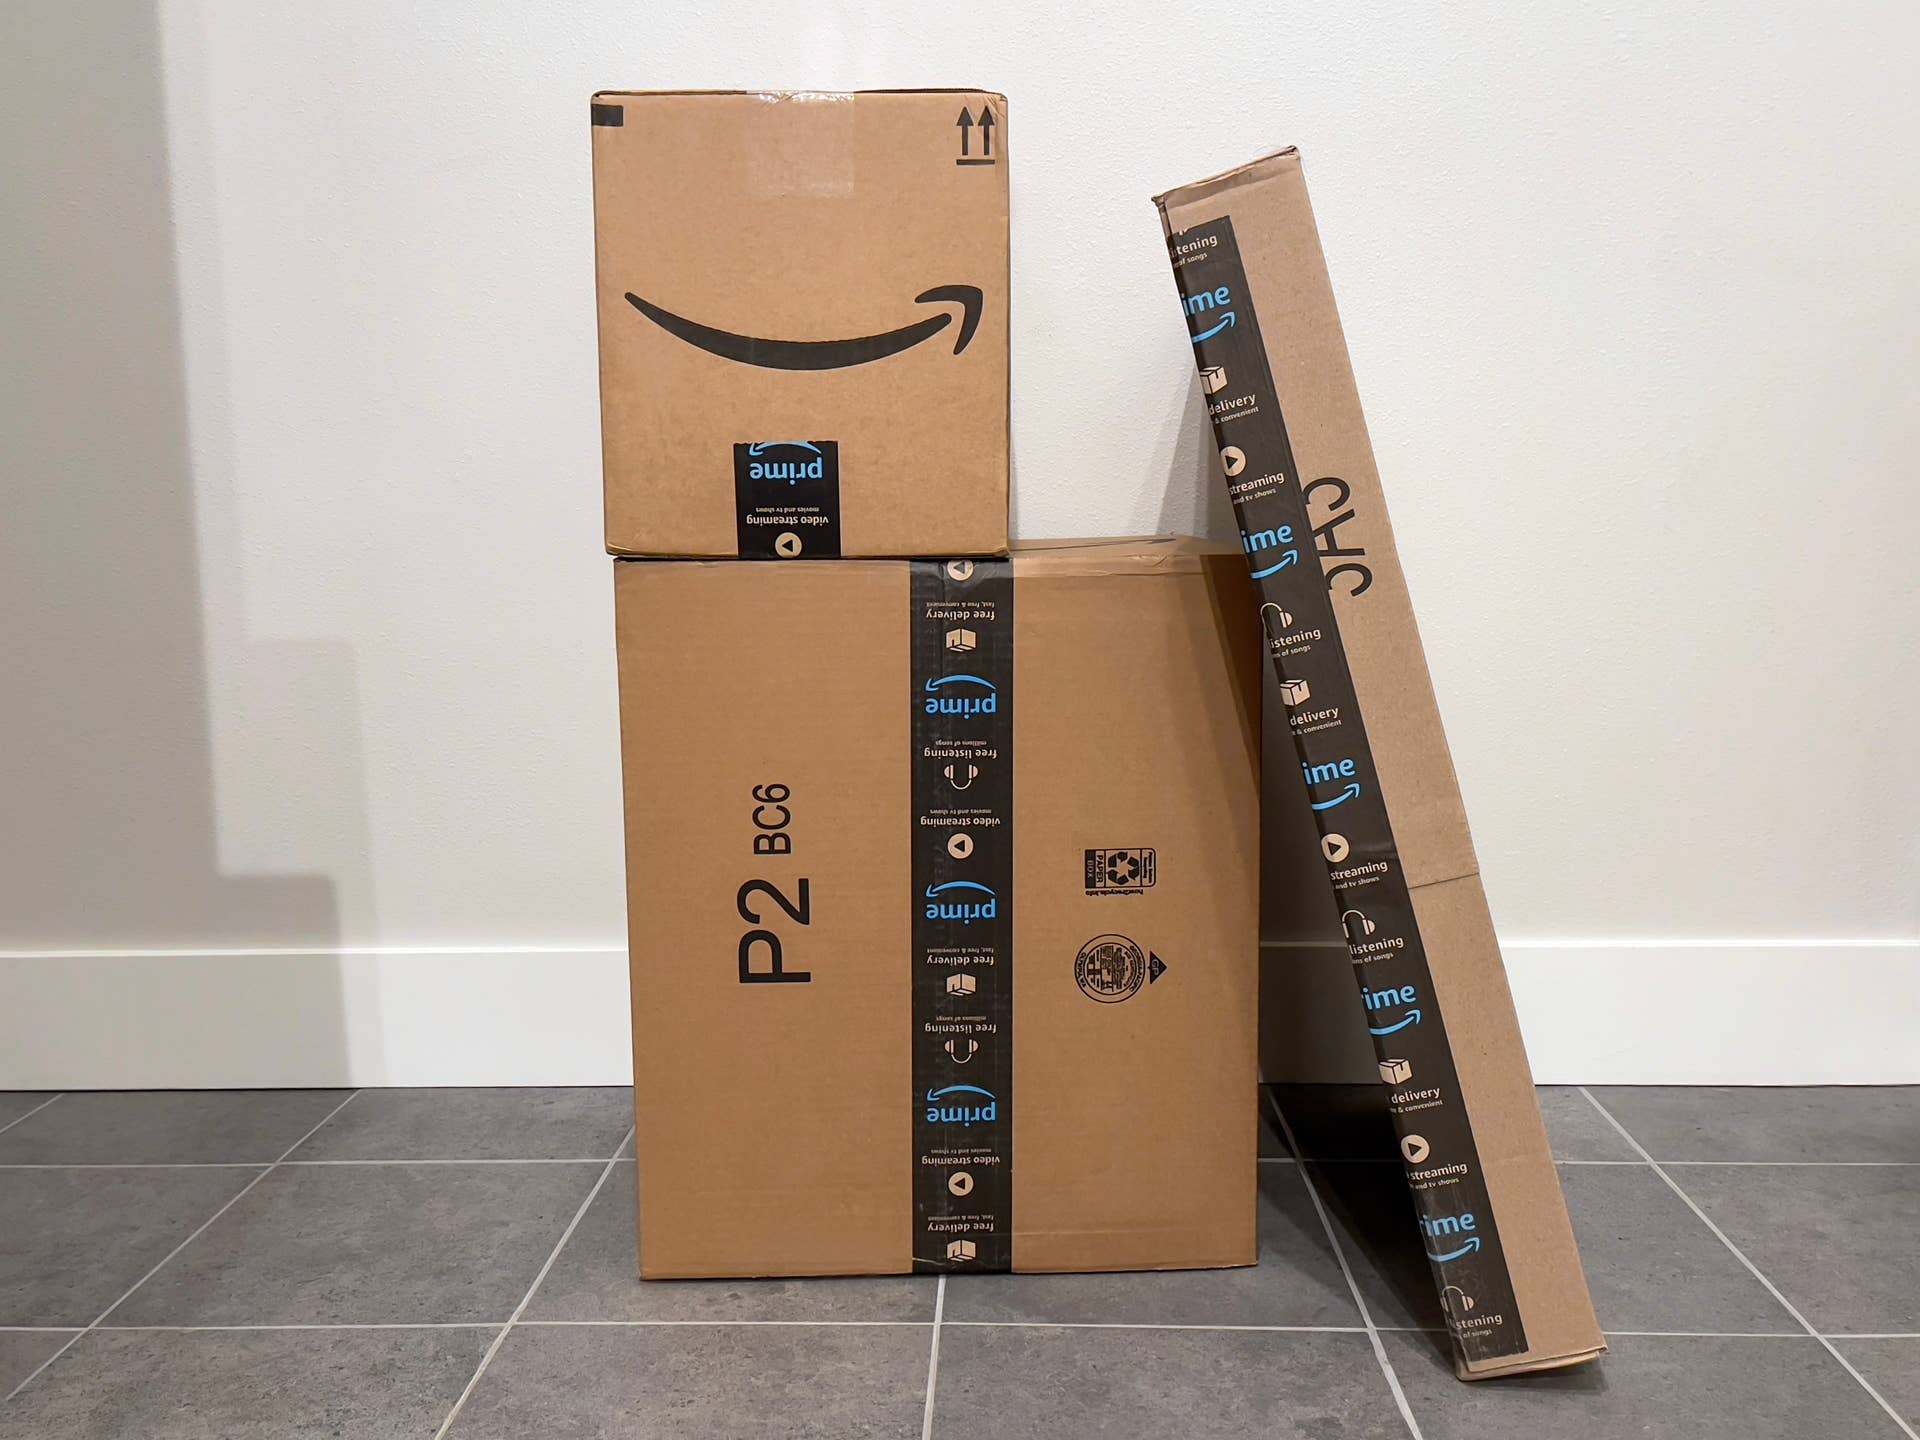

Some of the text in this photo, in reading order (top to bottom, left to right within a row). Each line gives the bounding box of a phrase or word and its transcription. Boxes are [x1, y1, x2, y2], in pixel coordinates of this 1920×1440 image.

[1186, 252, 1208, 263] songs
[1208, 394, 1256, 416] delivery
[1220, 406, 1259, 422] convenient
[749, 457, 823, 485] prime
[1229, 472, 1285, 495] streaming
[1254, 488, 1277, 500] shows
[746, 514, 829, 527] video streaming
[926, 609, 995, 621] free delivery
[1290, 644, 1311, 654] songs
[925, 692, 997, 719] prime
[1290, 707, 1339, 726] delivery
[1303, 719, 1342, 734] convenient
[924, 747, 997, 759] free listening
[920, 816, 1001, 828] video streaming
[1096, 854, 1104, 883] PAPER
[1330, 861, 1388, 880] streaming
[737, 783, 811, 983] P2 BC6
[1357, 875, 1380, 886] shows
[925, 898, 997, 925] prime
[1349, 937, 1404, 955] listening
[926, 955, 994, 966] free delivery
[1151, 959, 1159, 976] GP
[1361, 985, 1416, 1010] ime
[924, 1022, 997, 1034] free listening
[1391, 1087, 1440, 1104] delivery
[926, 1101, 996, 1127] prime
[921, 1155, 1000, 1166] video streaming
[1411, 1163, 1468, 1180] streaming
[927, 1222, 994, 1232] free delivery
